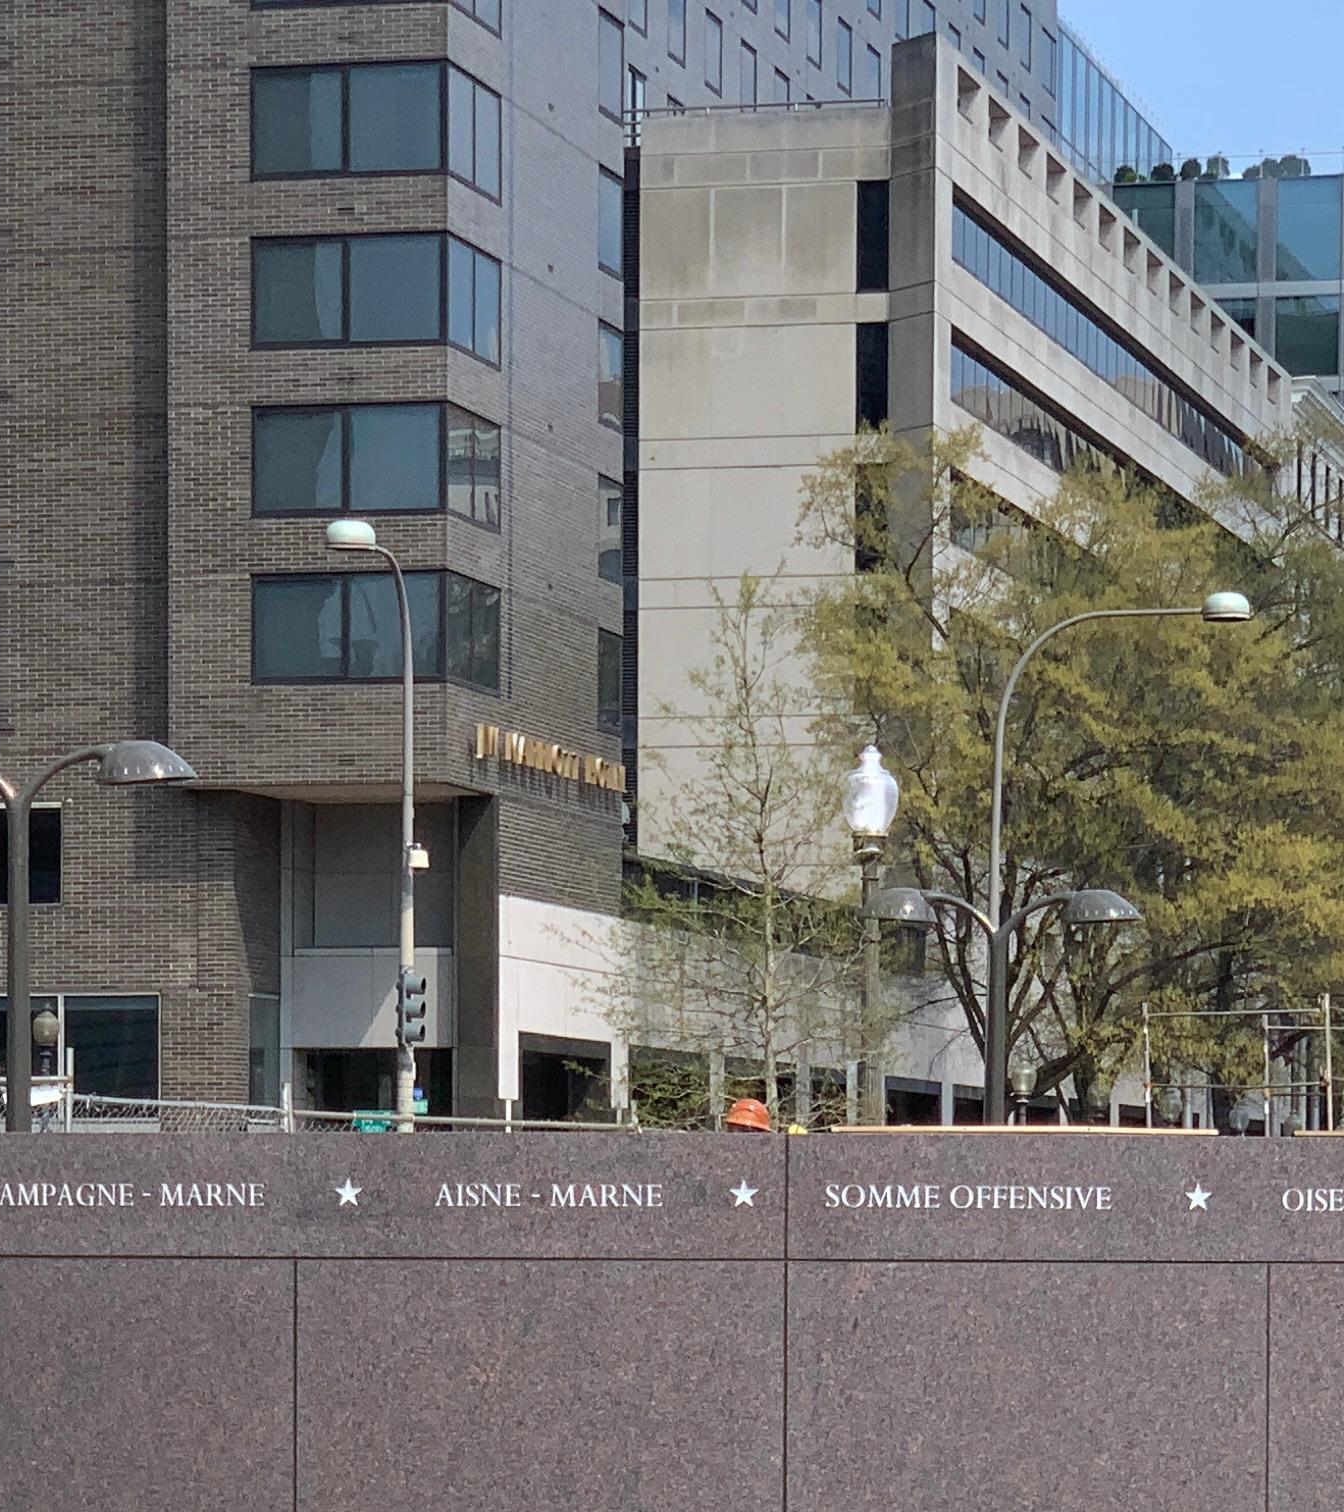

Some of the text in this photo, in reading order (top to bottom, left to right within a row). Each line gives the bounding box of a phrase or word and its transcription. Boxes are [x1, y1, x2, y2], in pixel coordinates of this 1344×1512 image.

[159, 1183, 266, 1207] MARNE
[434, 1184, 521, 1208] AISNE
[550, 1184, 663, 1208] MARNE
[825, 1184, 941, 1211] SOMME
[949, 1185, 1112, 1211] OFFENSIVE
[1282, 1188, 1344, 1213] OISE
